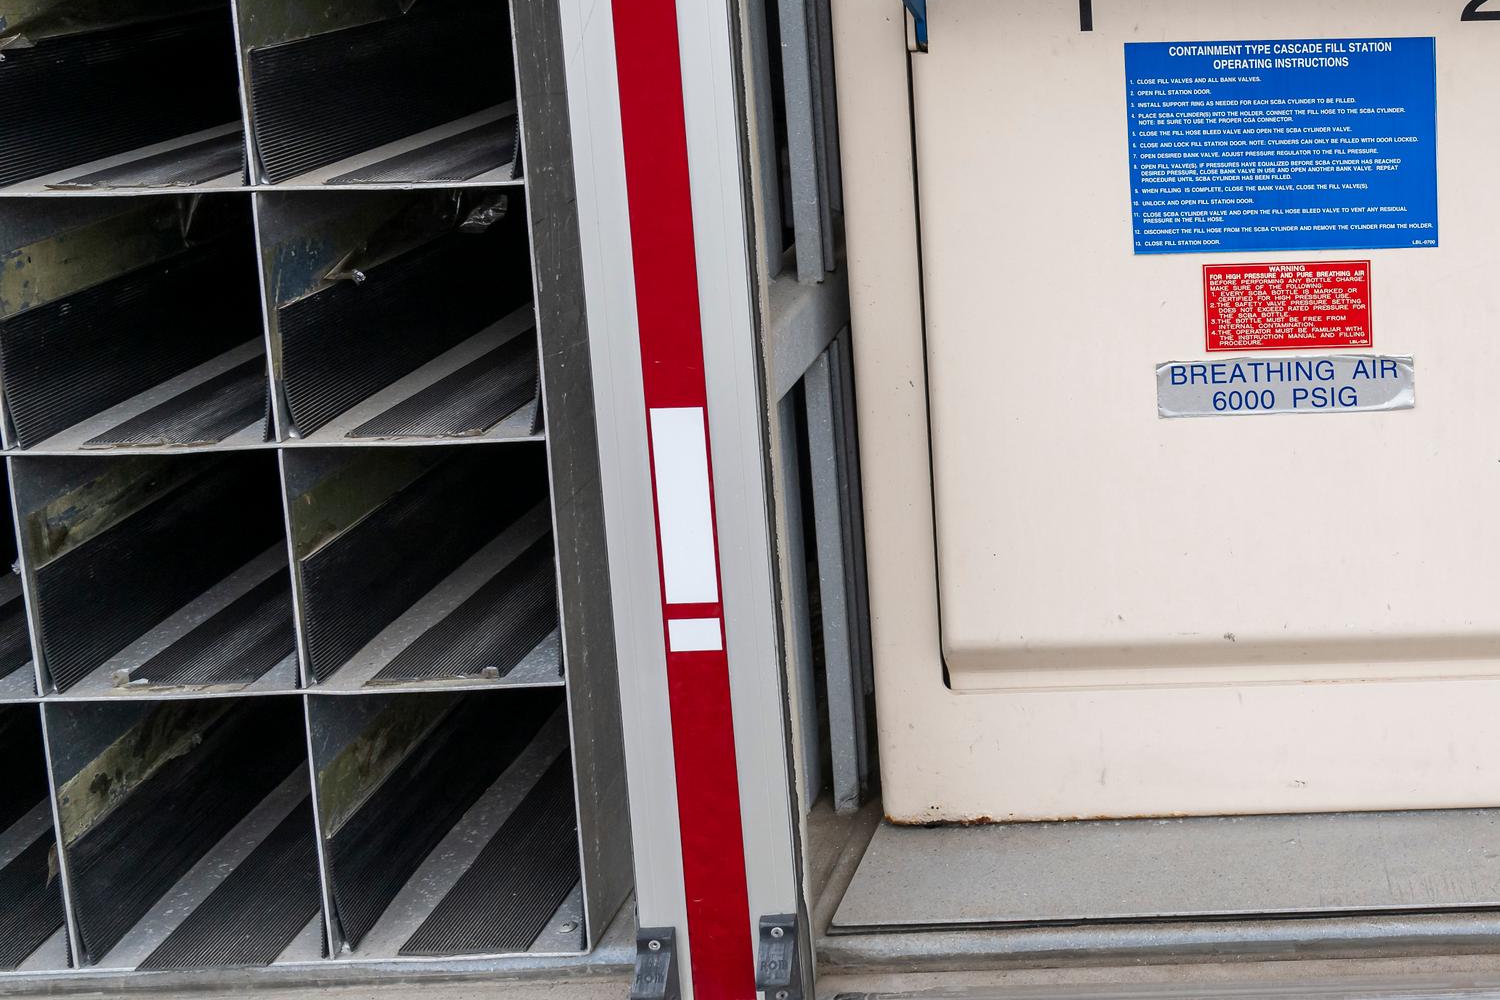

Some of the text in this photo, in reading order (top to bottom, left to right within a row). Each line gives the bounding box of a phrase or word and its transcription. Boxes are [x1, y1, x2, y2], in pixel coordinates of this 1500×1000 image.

[1169, 42, 1392, 57] CONTAINMENT TYPE CASCADE FILL STATION
[1213, 57, 1349, 70] OPERATING INSTRUCTIONS
[1170, 359, 1399, 386] BREATHING AIR
[1212, 386, 1359, 411] 6000 PSIG
